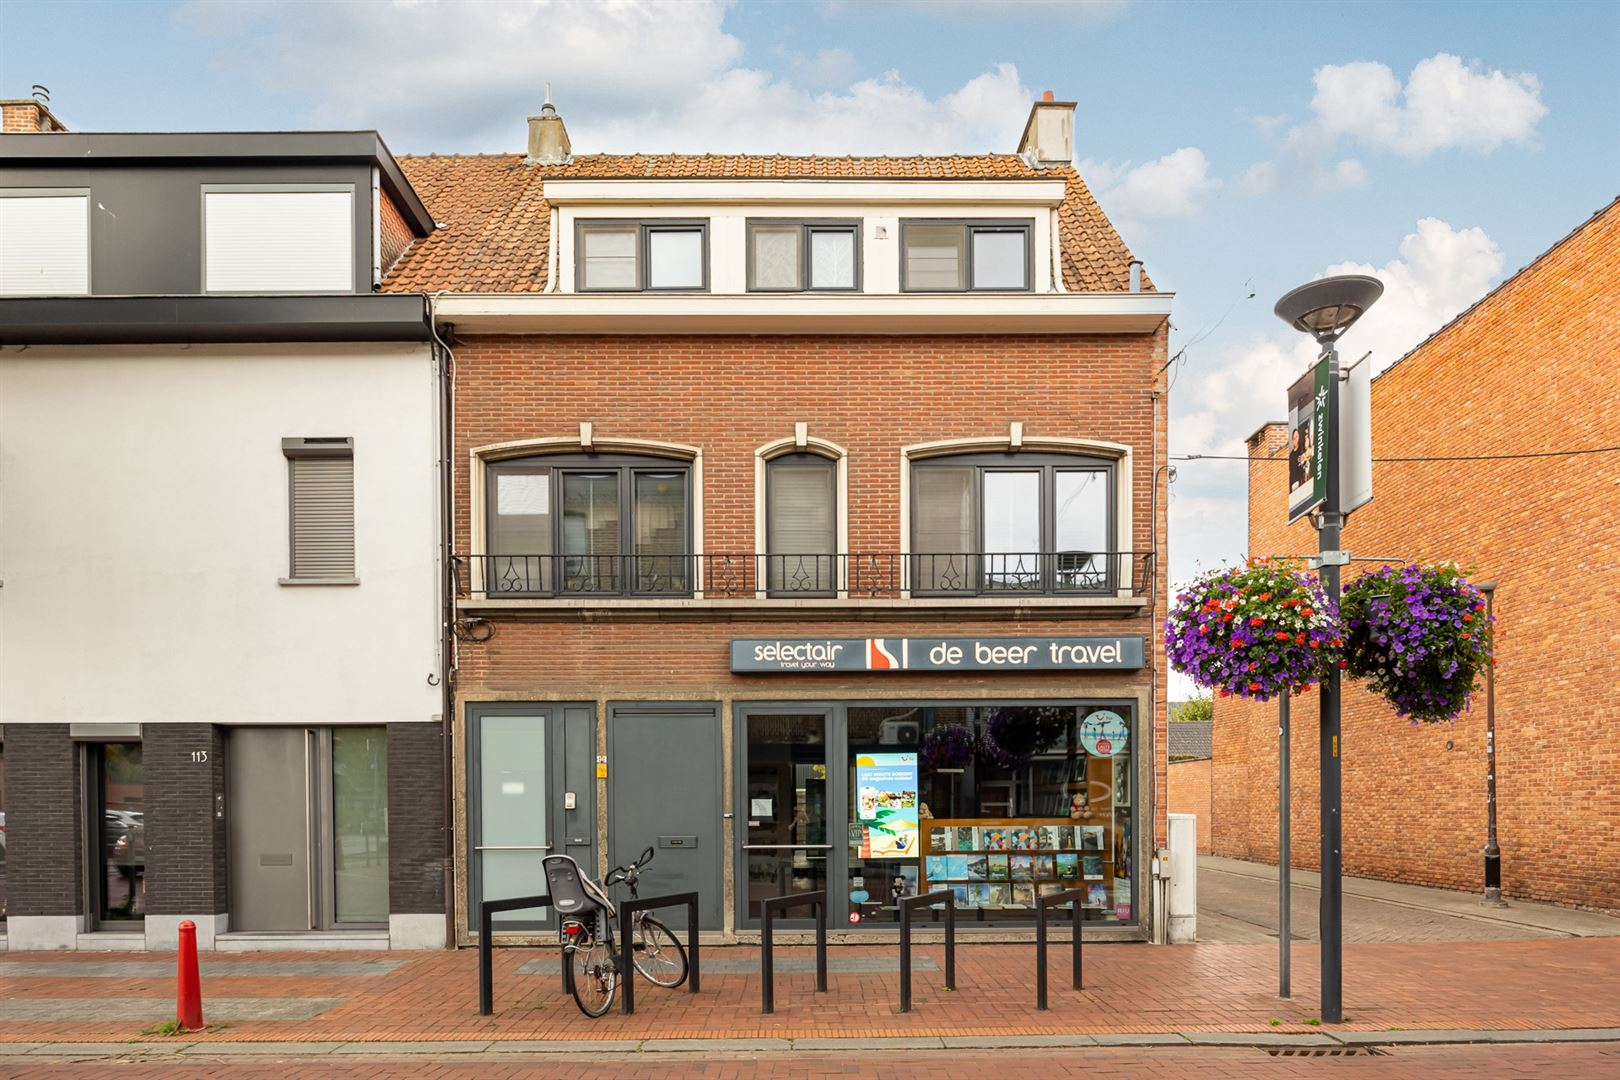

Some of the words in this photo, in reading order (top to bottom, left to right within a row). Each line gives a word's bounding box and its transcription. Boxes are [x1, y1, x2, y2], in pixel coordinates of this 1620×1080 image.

[754, 641, 843, 661] selectair
[929, 641, 963, 664] de
[975, 641, 1037, 664] beer
[1050, 640, 1122, 664] travel
[800, 661, 817, 669] your
[820, 661, 835, 669] way
[191, 751, 207, 762] 113
